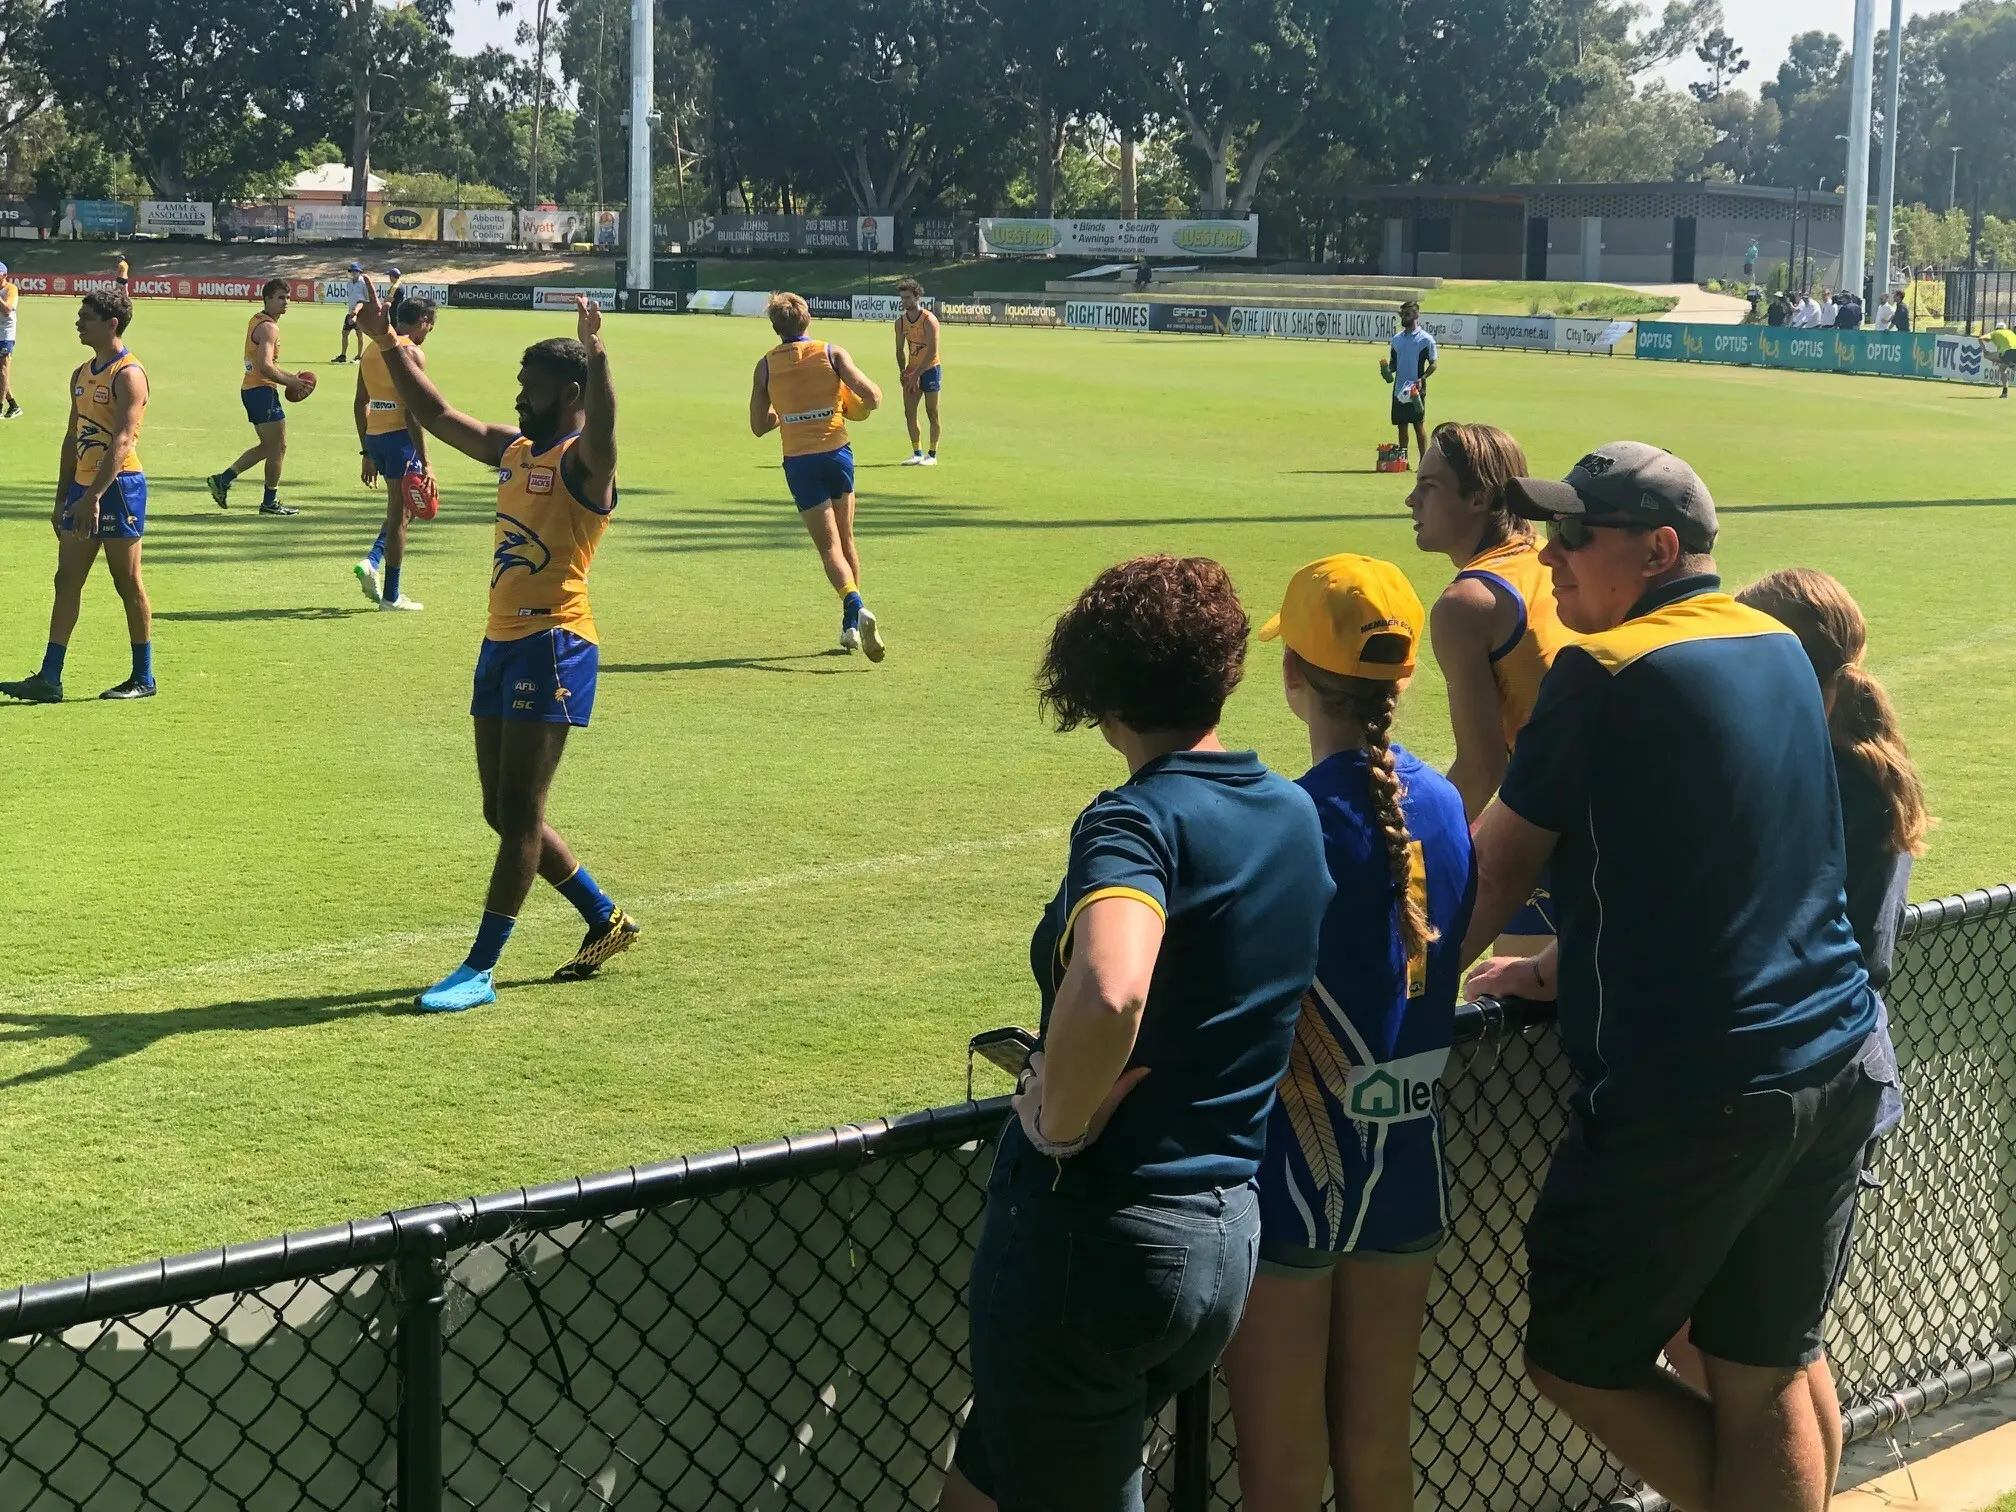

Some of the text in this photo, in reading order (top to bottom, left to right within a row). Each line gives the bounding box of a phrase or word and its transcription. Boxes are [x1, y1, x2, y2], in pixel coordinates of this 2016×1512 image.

[157, 203, 197, 212] CAMM &
[148, 211, 206, 220] ASSOCIATES
[472, 213, 505, 222] Abbotts
[469, 222, 505, 230] Industrial
[523, 221, 555, 234] Wyatt
[687, 216, 715, 245] JBS
[740, 220, 769, 231] JOHNS
[819, 219, 836, 231] STAR
[1080, 221, 1106, 231] Blinds
[1125, 222, 1160, 234] Security
[472, 231, 505, 240] Cooling
[717, 231, 790, 241] BUILDING SUPPLIES
[805, 234, 850, 247] WELSHPOOL
[1078, 234, 1115, 245] Awnings
[1123, 234, 1159, 244] Shutters
[73, 279, 118, 292] HUNG
[197, 282, 251, 297] HUNGRY
[411, 285, 447, 304] Cooling
[458, 292, 531, 301] MICHAELKEIL.COM
[585, 290, 614, 299] Welshpool
[642, 296, 674, 307] Carlisle
[853, 296, 885, 311] walker
[941, 301, 991, 316] liquorbarons
[1004, 302, 1056, 318] liquorbarons
[1172, 307, 1208, 318] GRAND
[1066, 304, 1147, 327] RIGHT HOMES
[1243, 310, 1313, 335] THE LUCKY SHAG
[1328, 312, 1397, 338] THE LUCKY SHAG
[1425, 321, 1447, 336] Toyota
[1482, 322, 1549, 340] citytoyota.net.au
[1566, 328, 1602, 345] City Toy
[1639, 325, 1934, 373] OPTUS yes OPTUS yes OPTUS yes OPTUS yes
[1359, 619, 1399, 633] MEMBER
[514, 681, 536, 691] AFL
[512, 700, 534, 710] ISC
